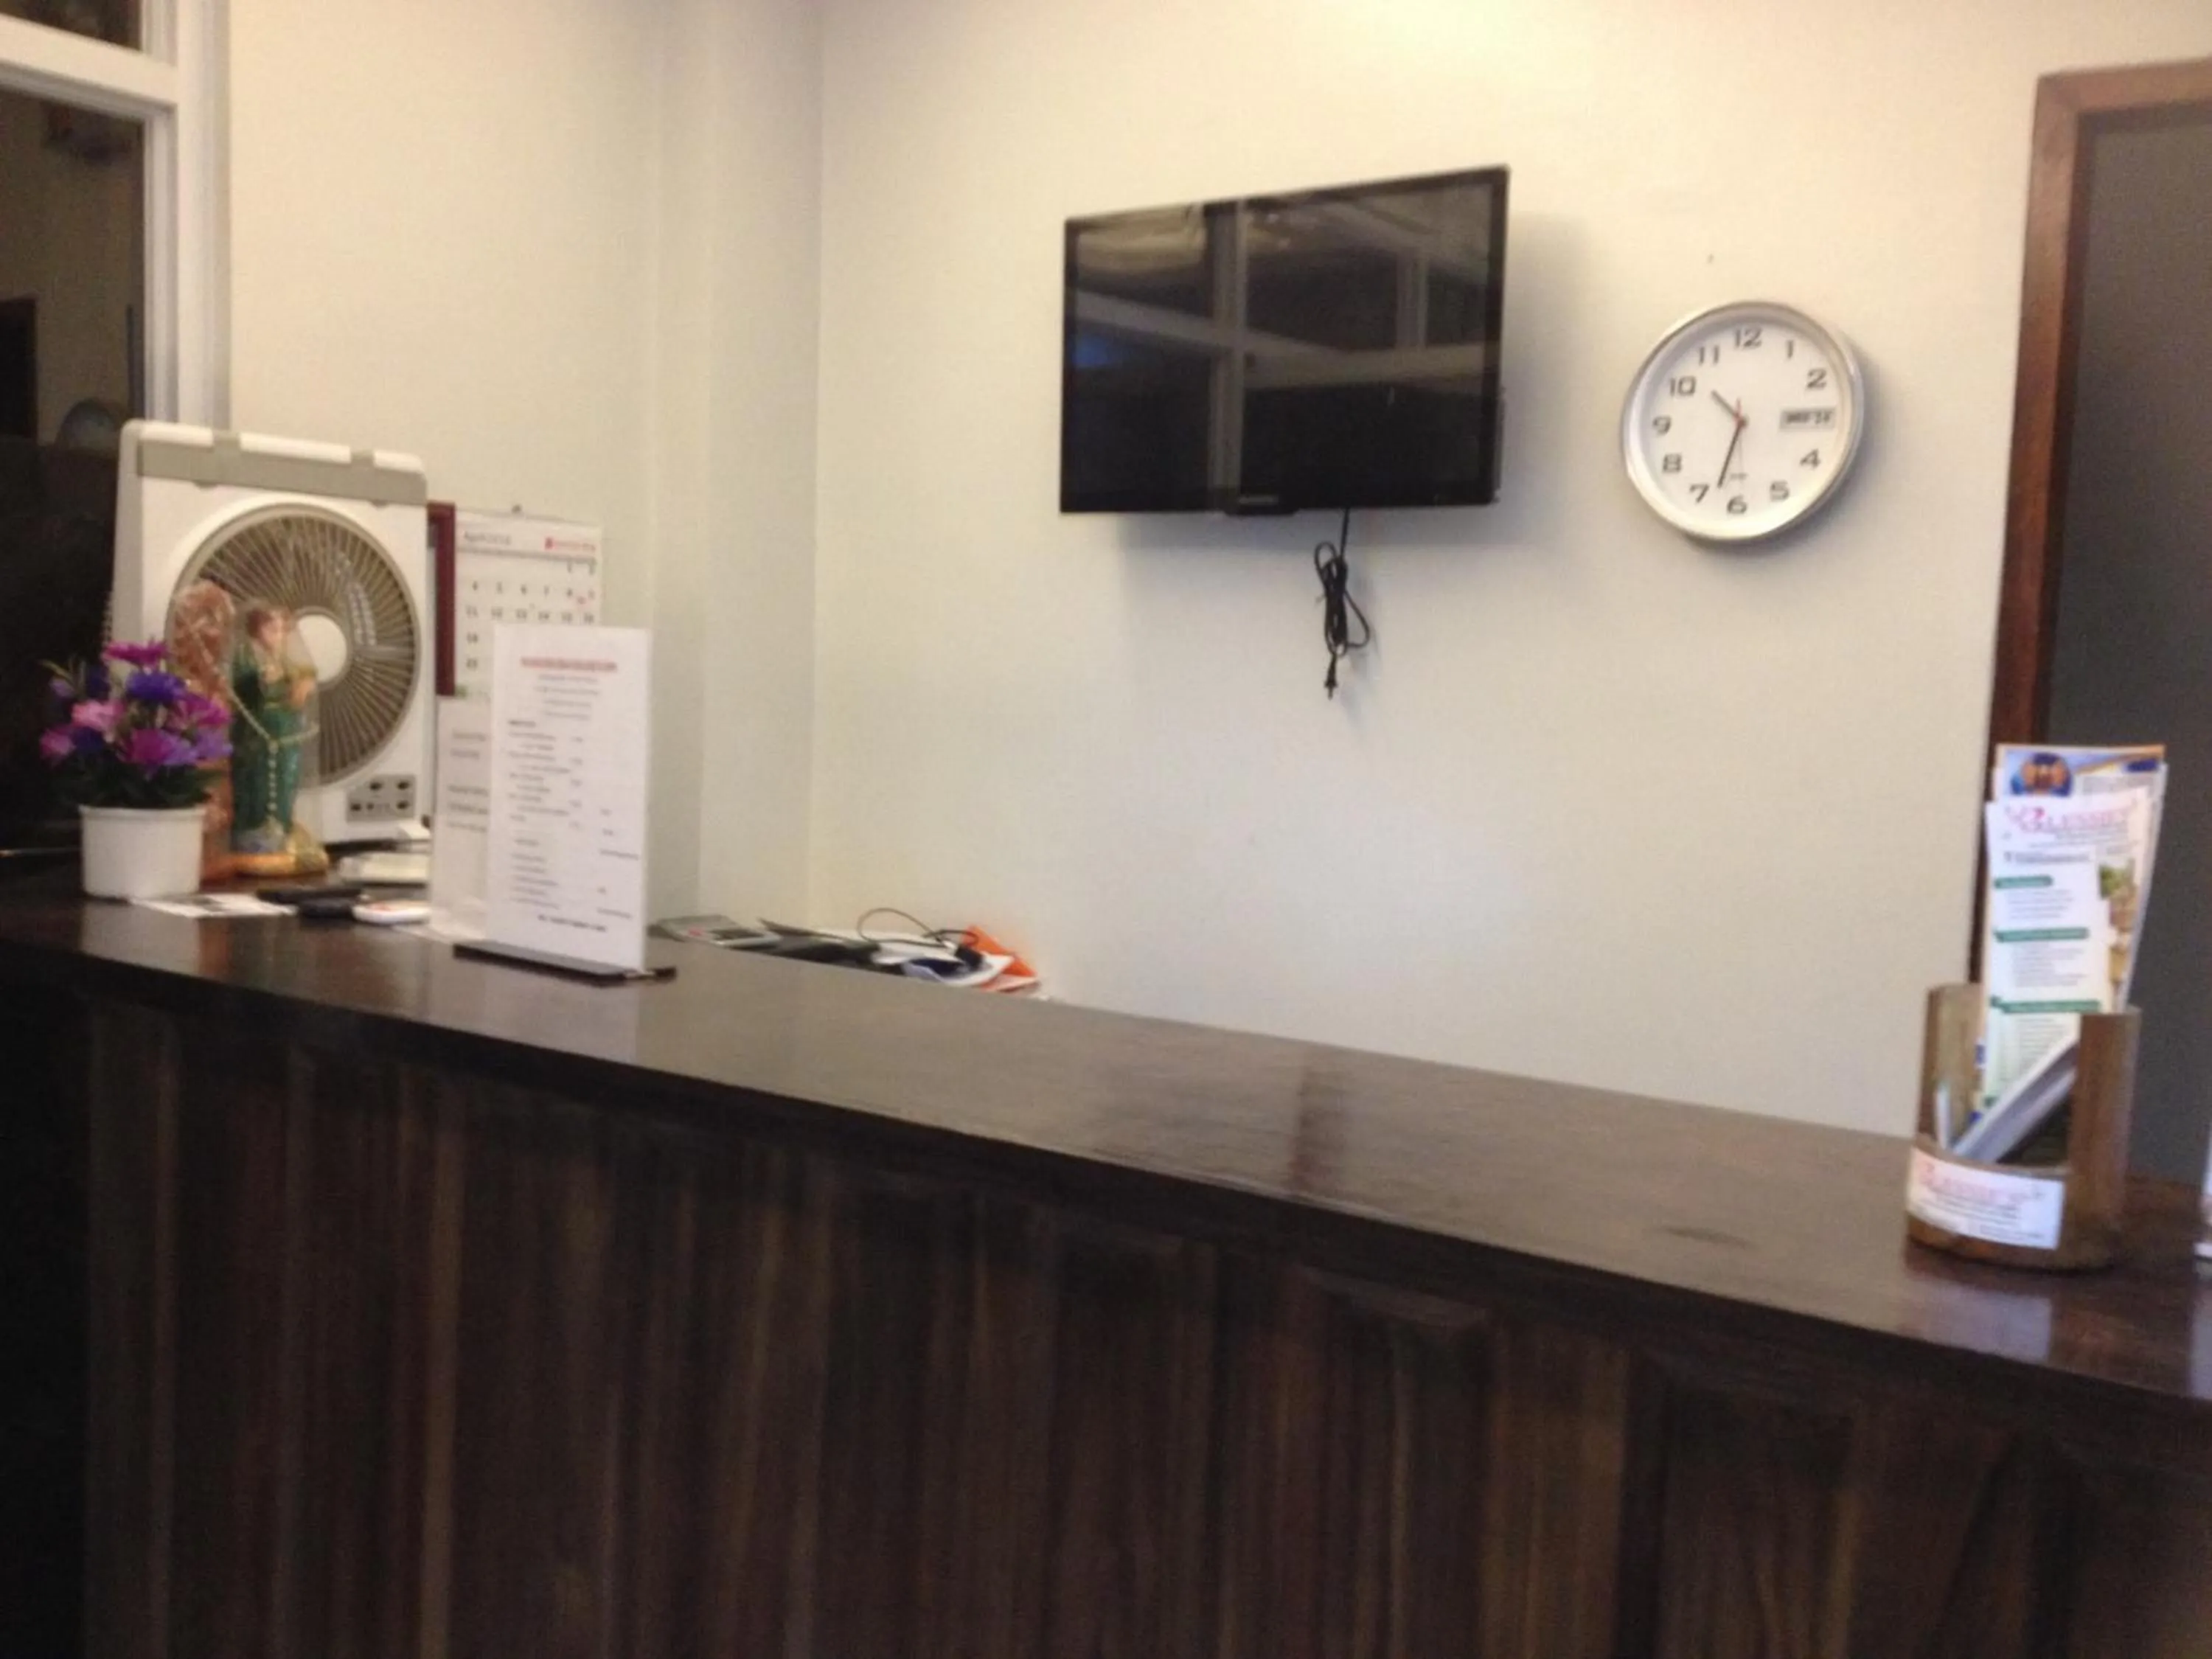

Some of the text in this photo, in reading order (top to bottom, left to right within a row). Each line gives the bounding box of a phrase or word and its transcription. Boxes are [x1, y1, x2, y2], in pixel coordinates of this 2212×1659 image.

[1735, 329, 1762, 348] 12
[1699, 345, 1719, 364] 11
[1786, 340, 1794, 358] 1
[1670, 376, 1696, 396] 10
[1806, 369, 1826, 389] 2
[1652, 416, 1671, 435] 9
[1663, 453, 1682, 473] 8
[1800, 449, 1820, 467] 4
[1690, 484, 1710, 503] 7
[1770, 481, 1789, 501] 5
[1727, 495, 1747, 514] 6
